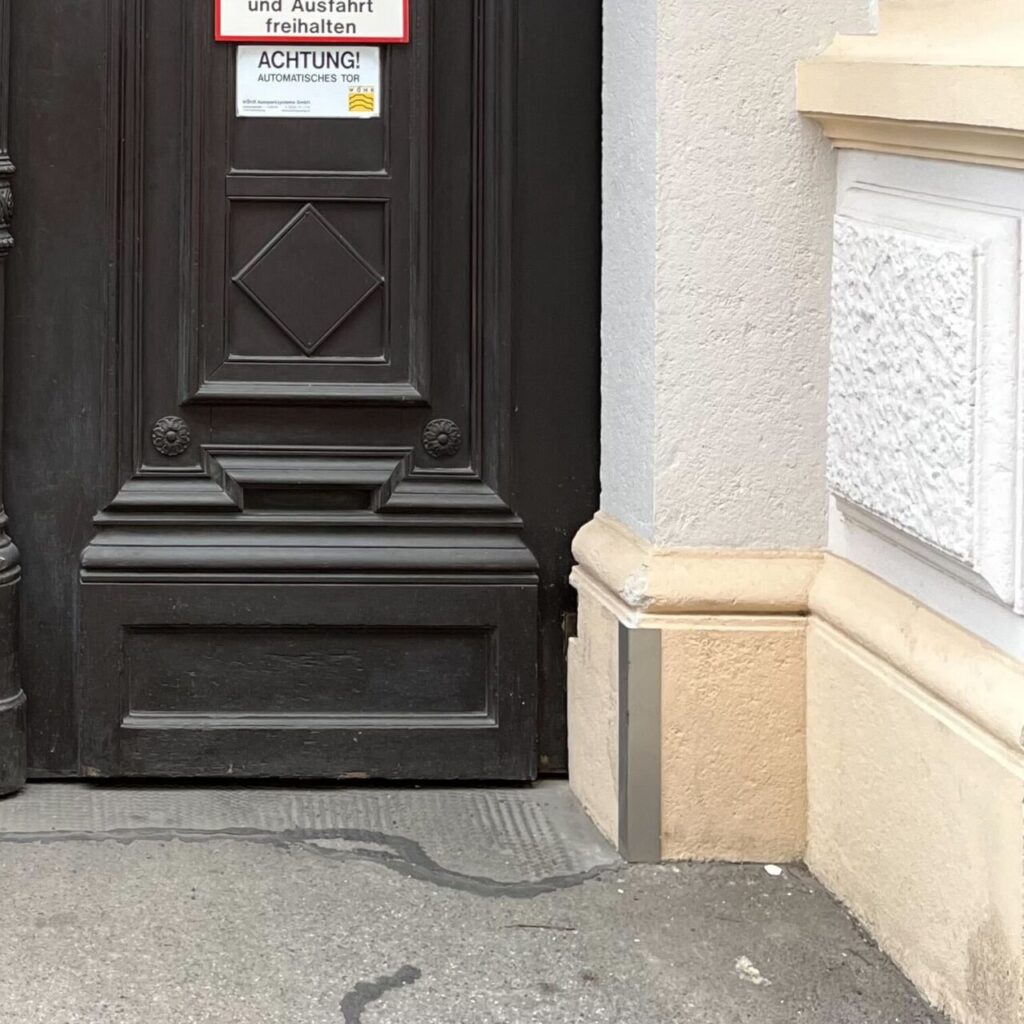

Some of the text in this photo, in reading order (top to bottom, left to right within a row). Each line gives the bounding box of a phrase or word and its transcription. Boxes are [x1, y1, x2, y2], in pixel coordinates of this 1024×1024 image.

[265, 18, 357, 34] freihalten
[257, 50, 360, 69] ACHTUNG!
[257, 73, 360, 83] AUTOMATISCHES TOR
